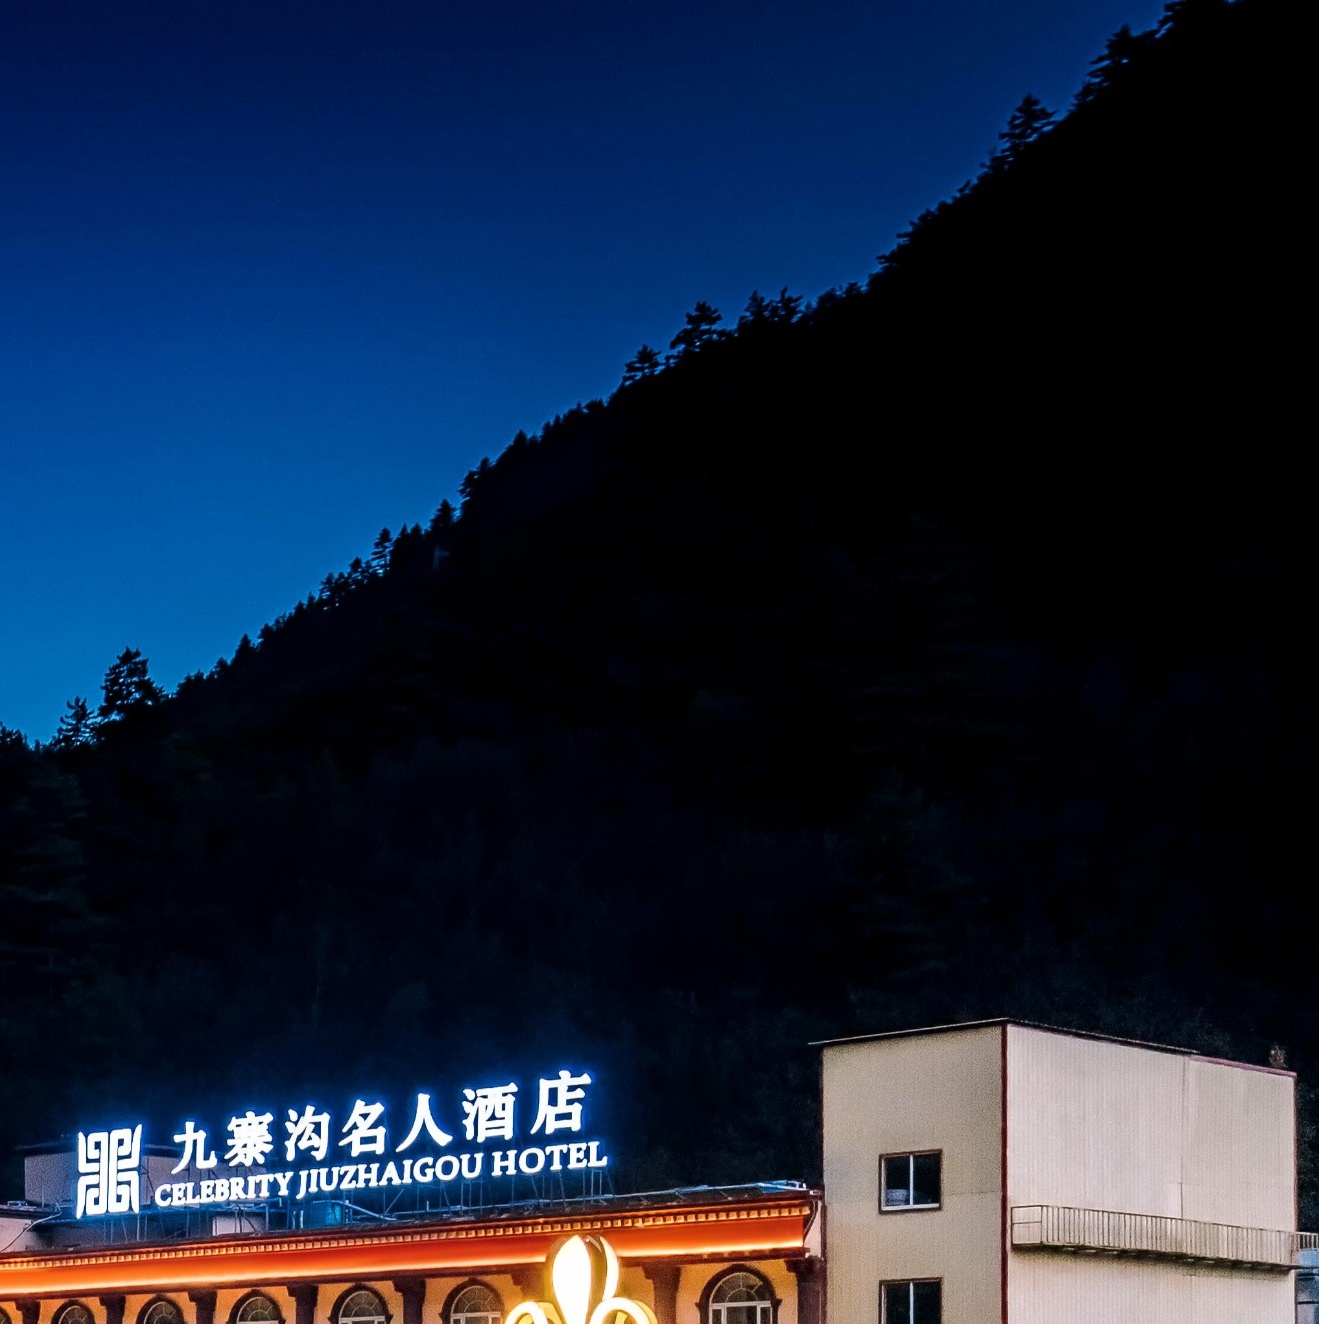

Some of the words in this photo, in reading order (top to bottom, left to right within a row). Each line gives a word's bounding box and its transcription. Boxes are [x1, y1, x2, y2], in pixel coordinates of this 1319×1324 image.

[170, 1070, 592, 1174] 九寨沟名人酒店
[154, 1171, 293, 1207] CELEBRITY
[296, 1152, 485, 1200] JIUZHAIGOU
[491, 1141, 608, 1177] HOTEL
